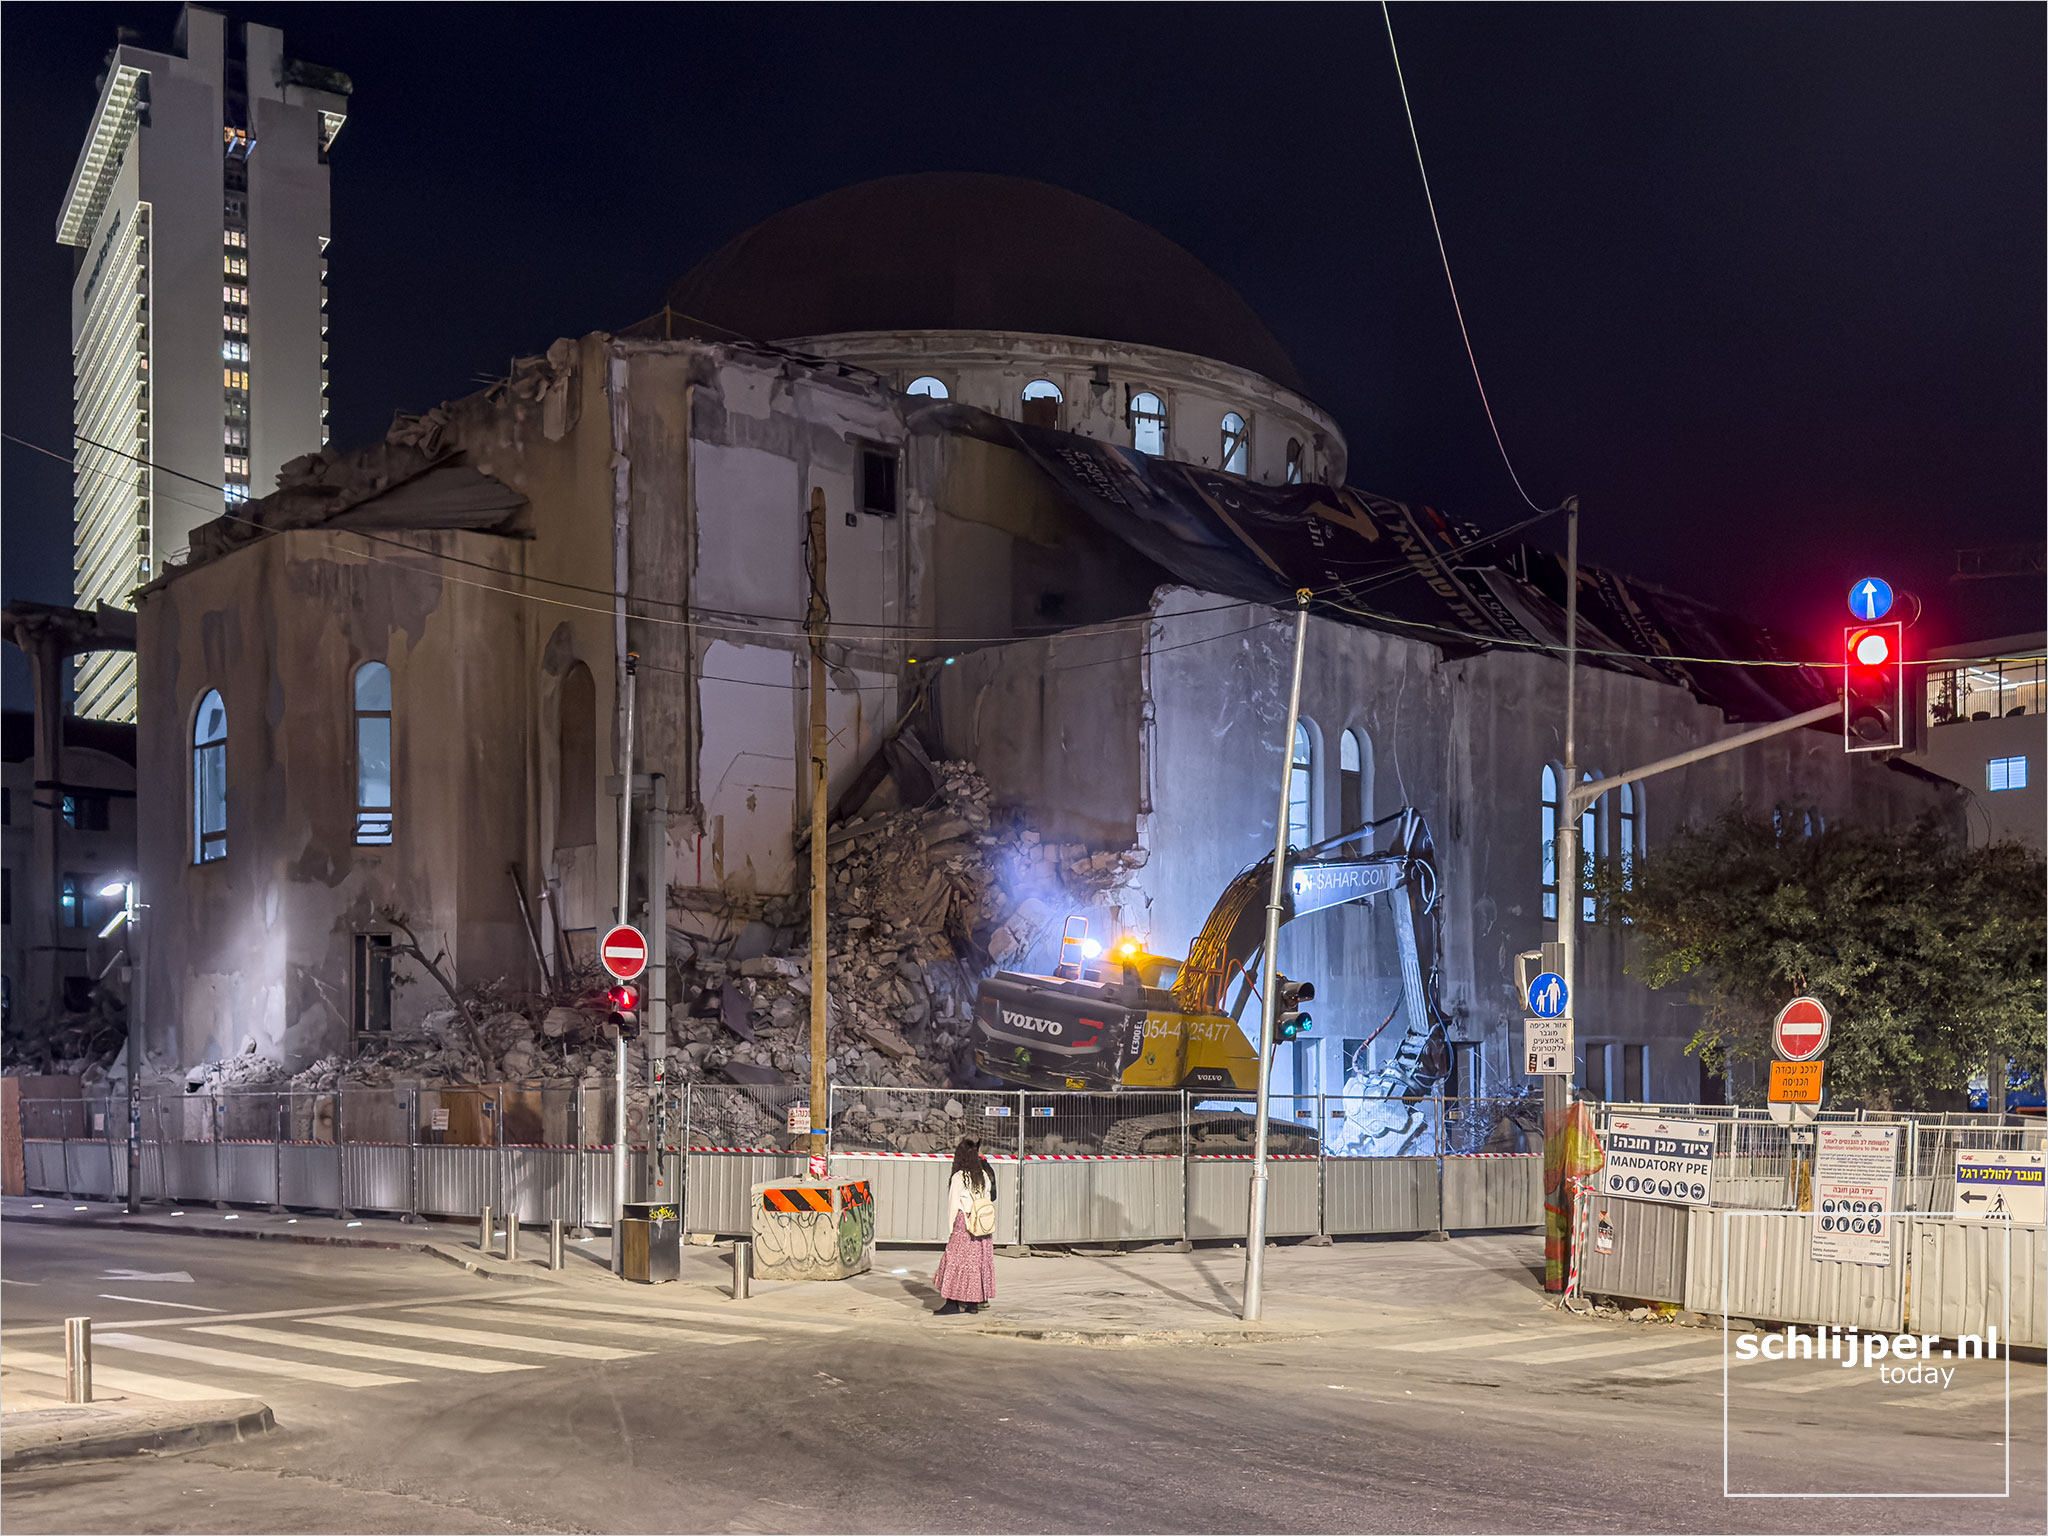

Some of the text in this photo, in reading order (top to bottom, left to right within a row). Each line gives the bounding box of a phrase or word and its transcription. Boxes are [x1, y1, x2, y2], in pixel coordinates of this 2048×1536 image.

[1002, 1009, 1063, 1036] VOLVO
[1775, 1065, 1818, 1075] לרכב עבודה
[1782, 1078, 1809, 1086] הכניסה
[1782, 1090, 1808, 1099] מותרת
[1613, 1135, 1709, 1156] ציוד מגן חובה!
[1610, 1155, 1708, 1175] MANDATORY PPE
[1960, 1166, 2042, 1182] מעבר להולכי רגל
